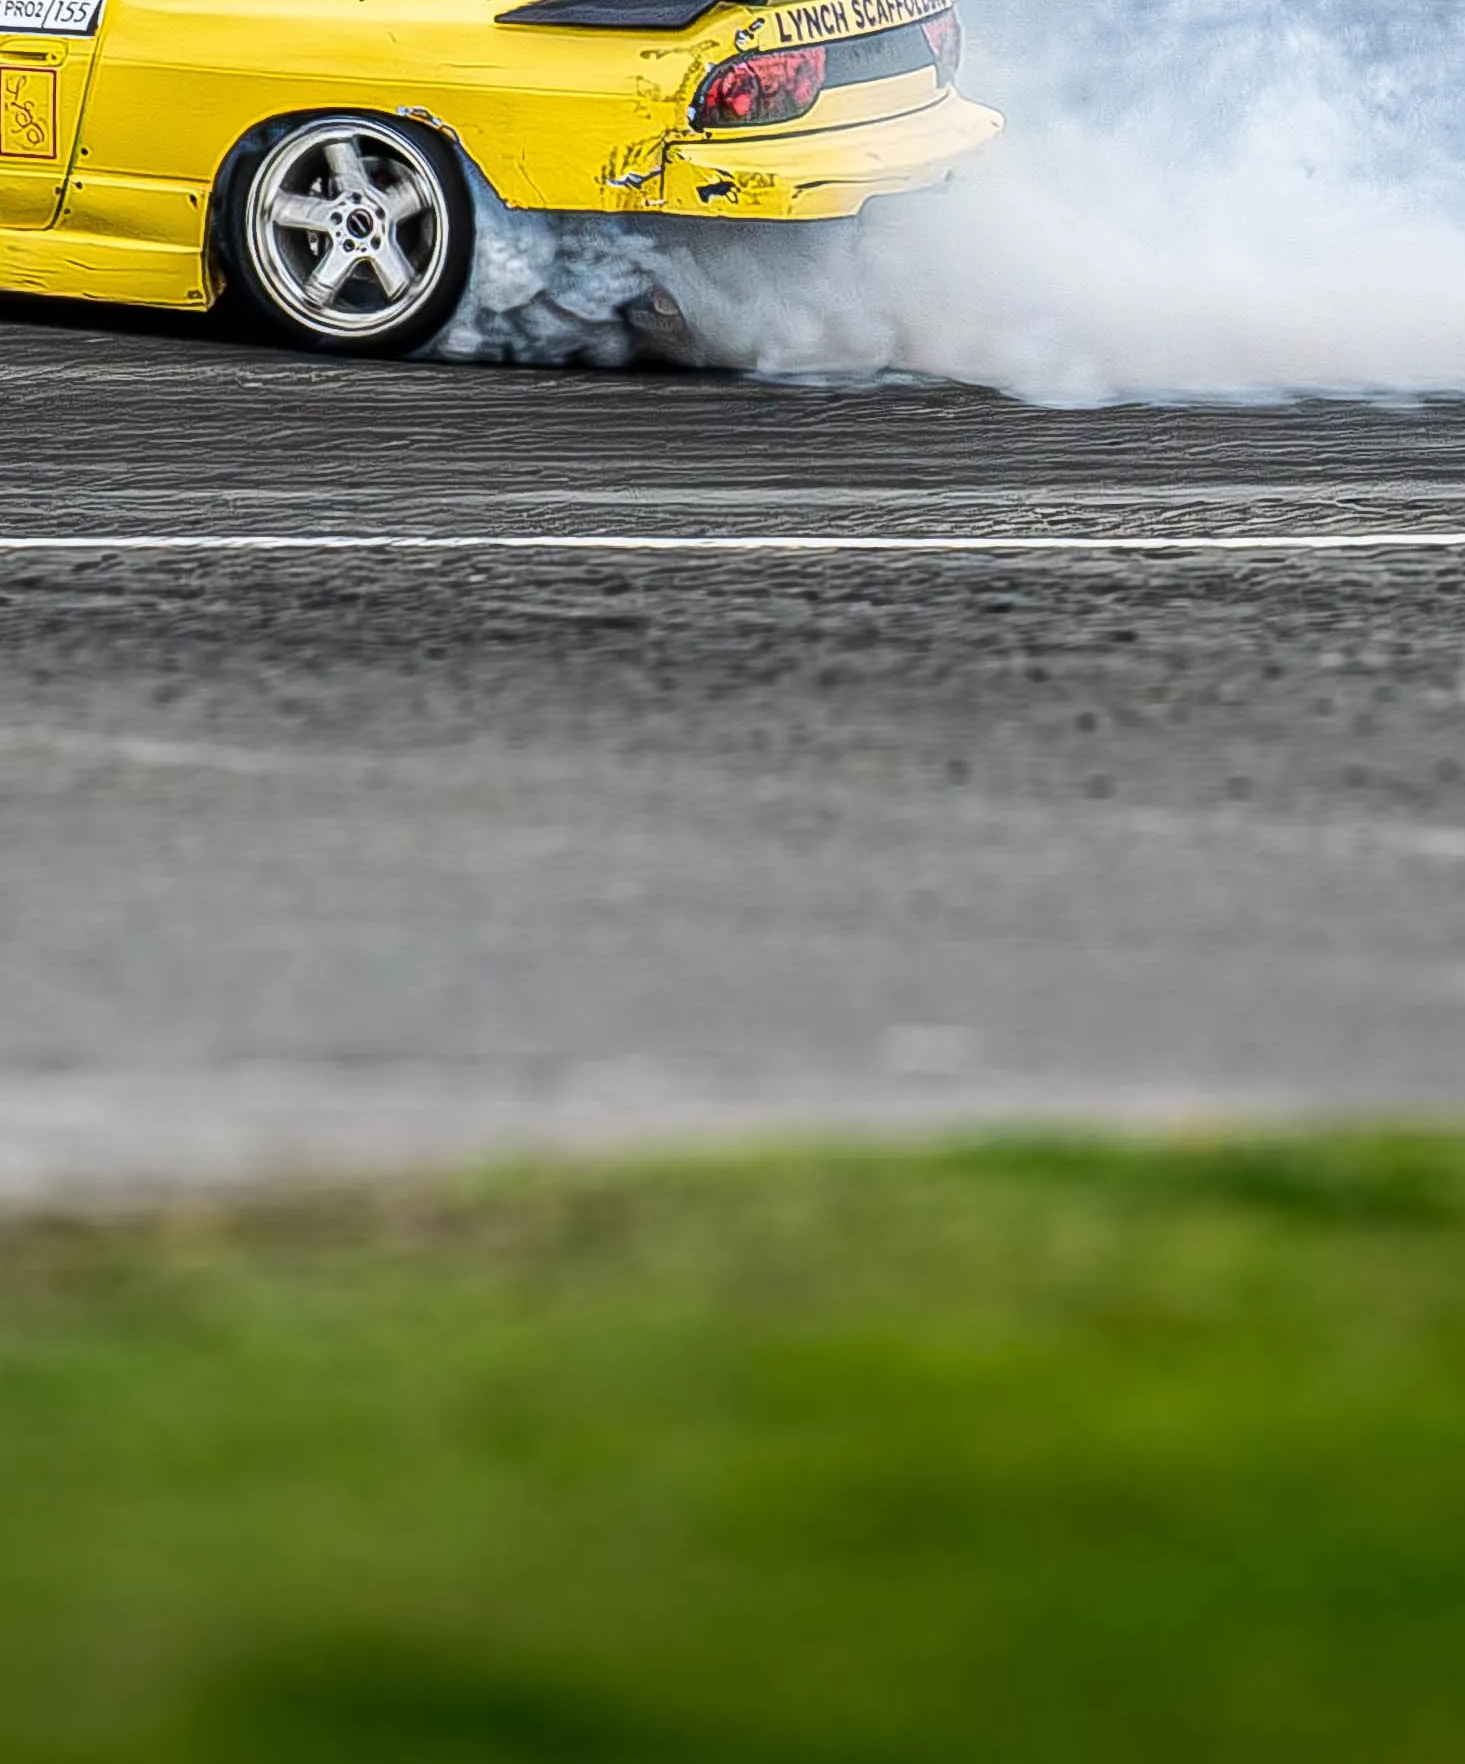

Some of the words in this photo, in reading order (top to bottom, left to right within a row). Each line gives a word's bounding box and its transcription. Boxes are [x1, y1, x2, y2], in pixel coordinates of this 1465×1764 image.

[4, 0, 45, 18] PRO2
[54, 1, 91, 23] 155
[775, 1, 850, 43] LYNCH
